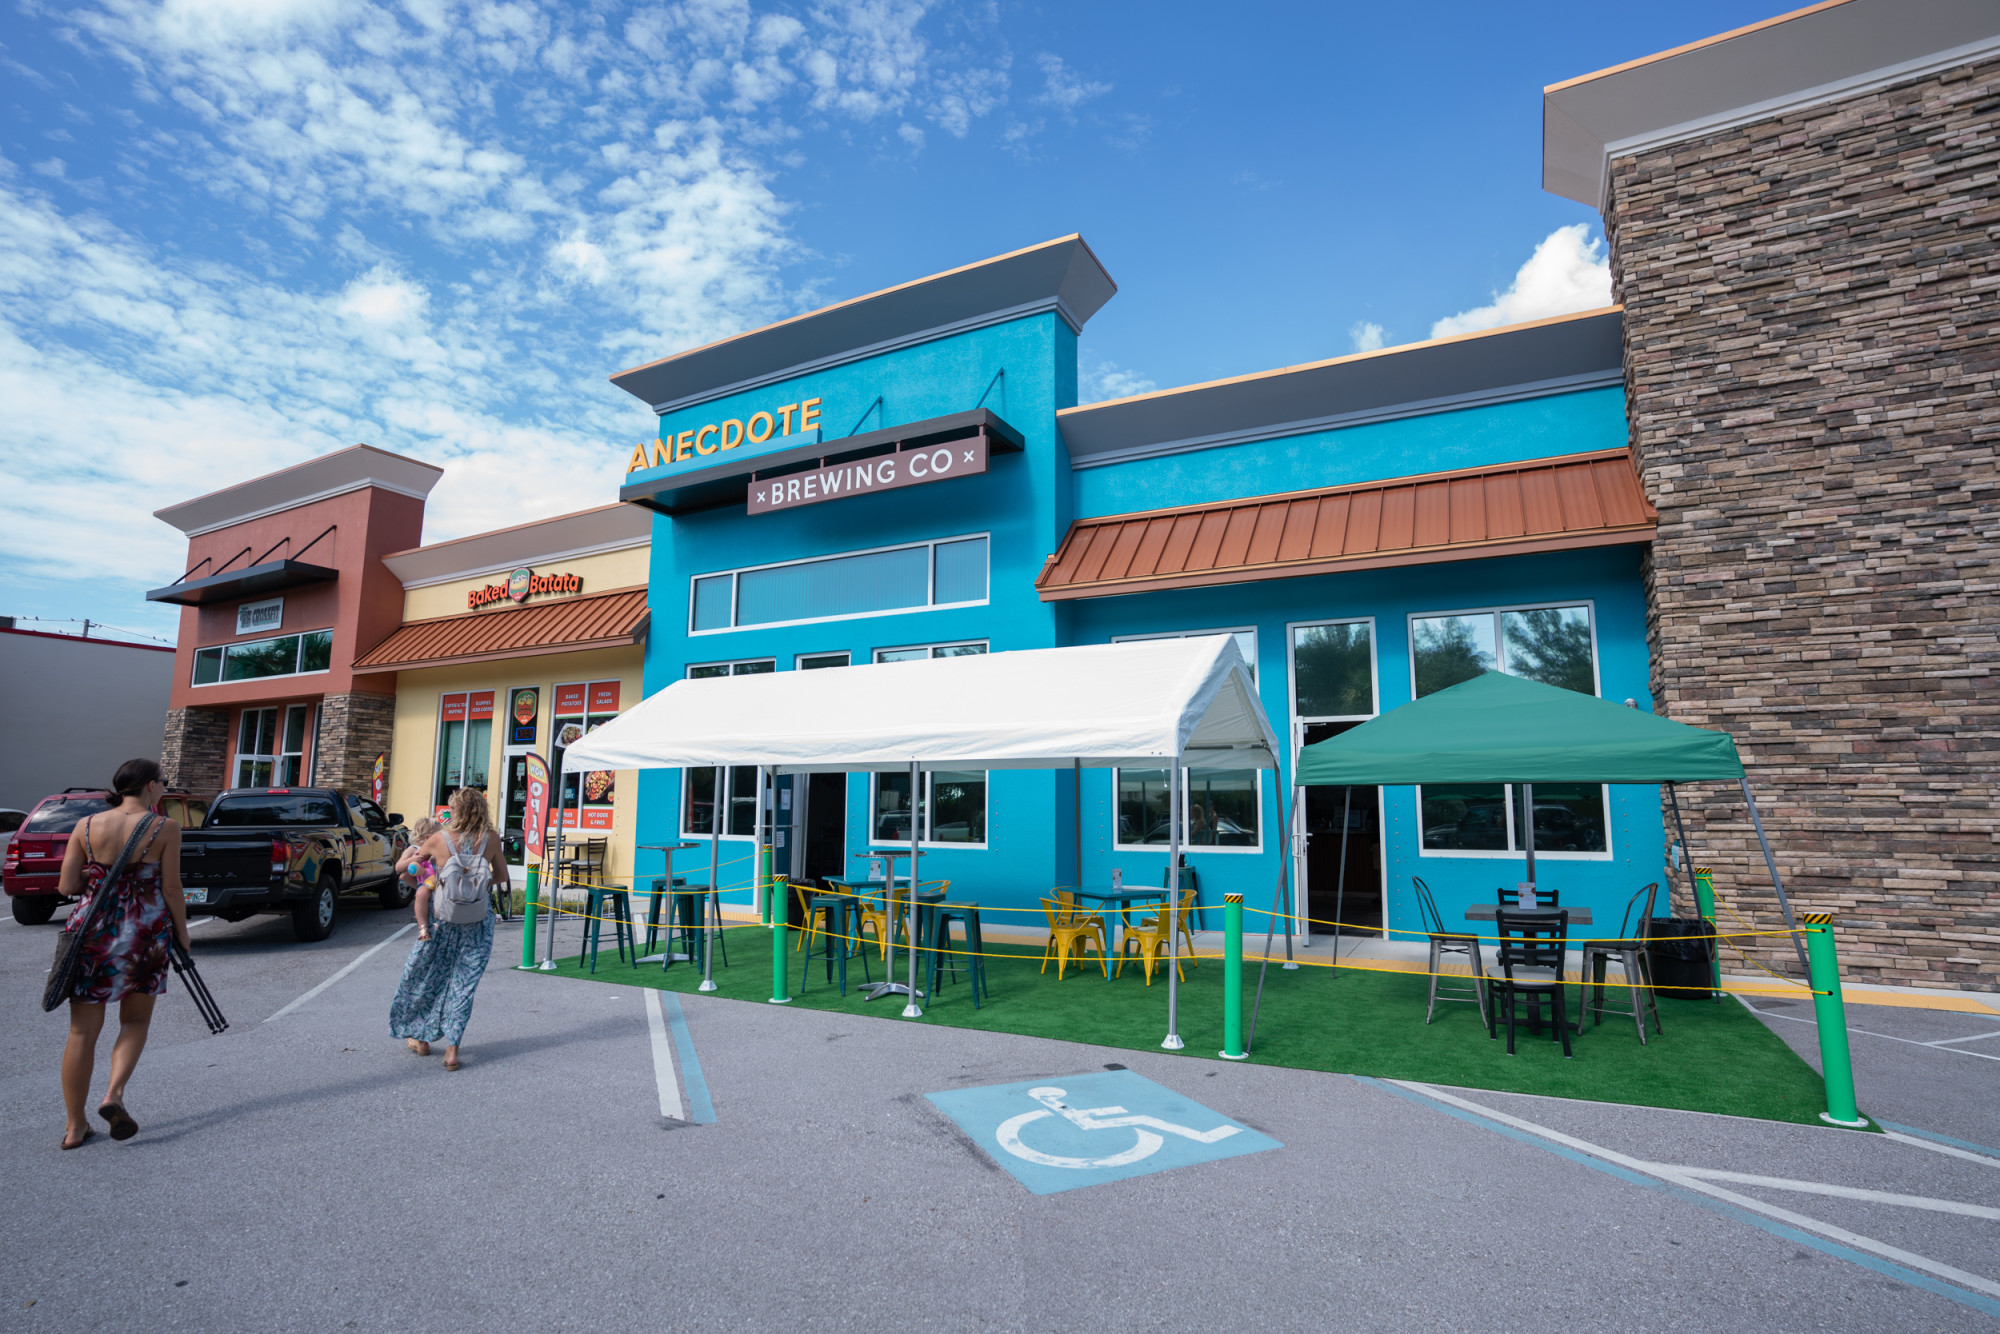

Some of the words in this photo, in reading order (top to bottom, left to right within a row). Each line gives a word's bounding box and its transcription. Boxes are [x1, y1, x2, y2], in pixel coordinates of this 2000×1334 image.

[626, 397, 822, 474] ANECDOTE
[771, 460, 896, 505] BREWING
[909, 449, 953, 478] CO
[468, 578, 509, 609] Baked
[529, 572, 581, 594] Batata
